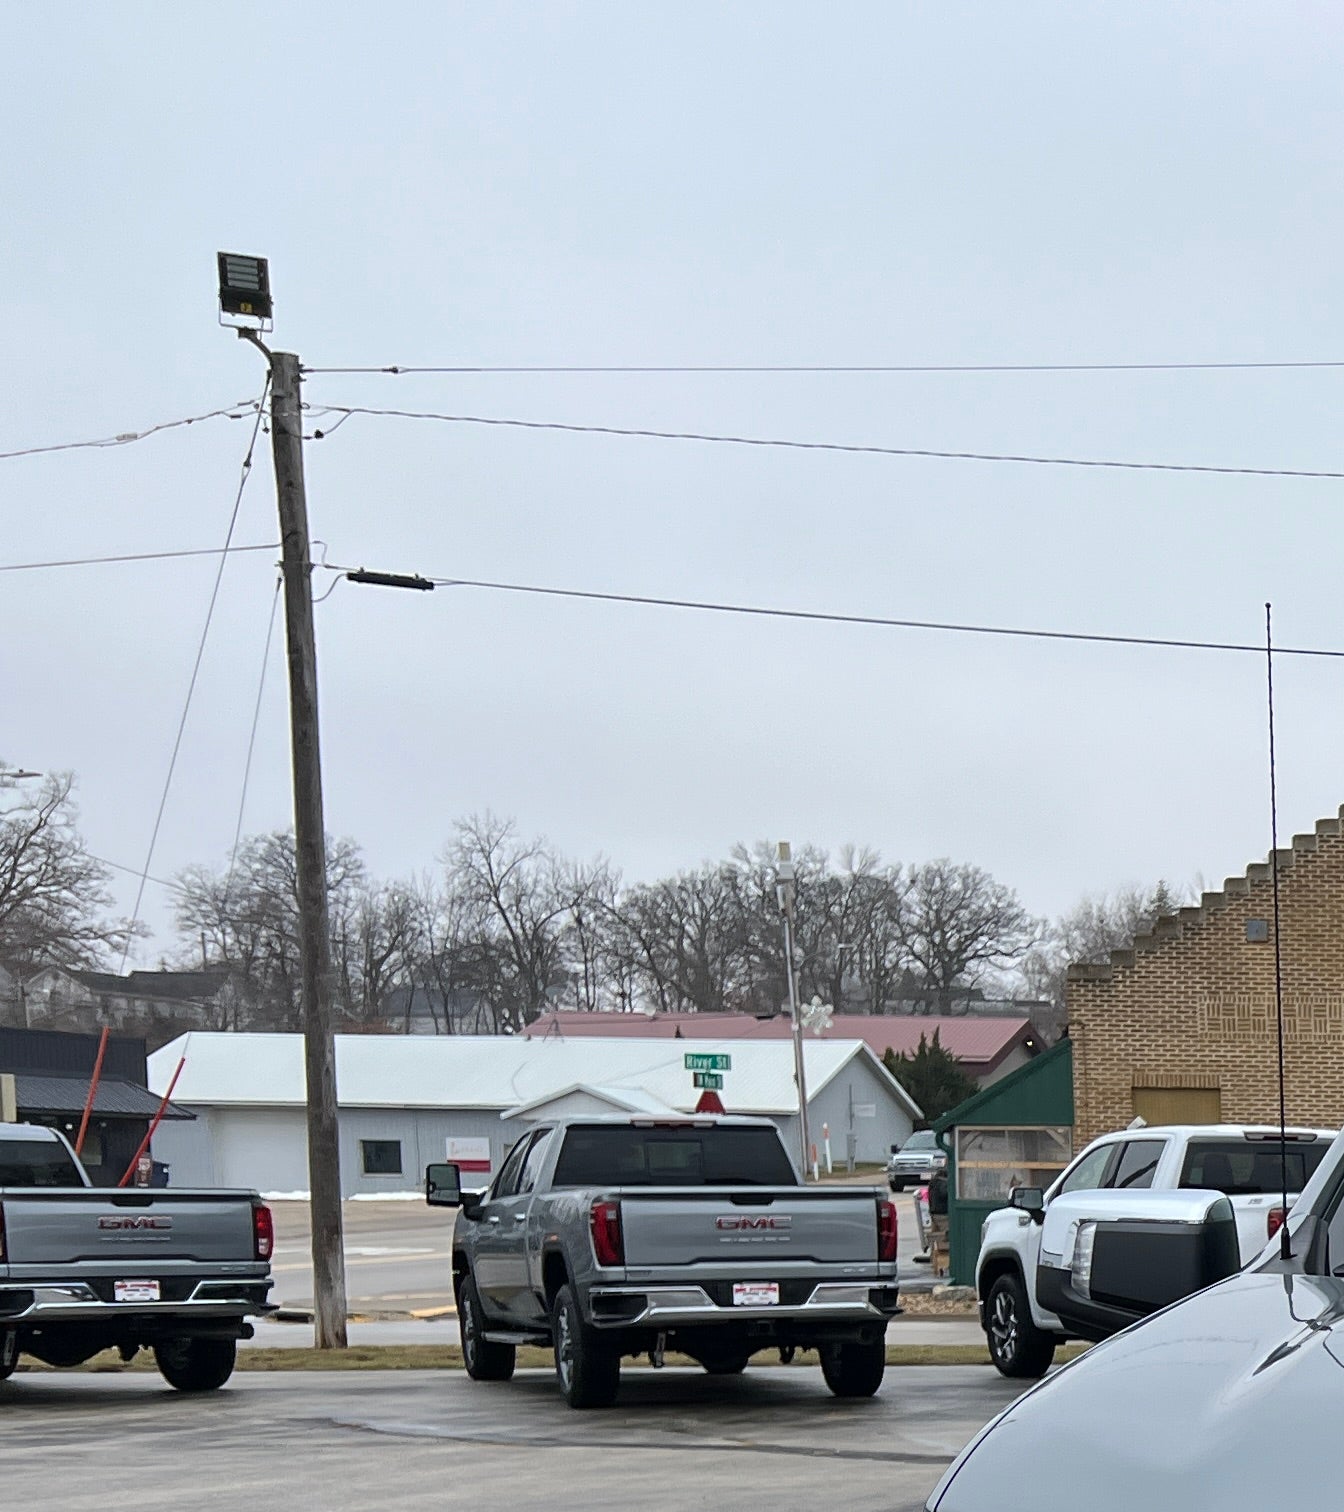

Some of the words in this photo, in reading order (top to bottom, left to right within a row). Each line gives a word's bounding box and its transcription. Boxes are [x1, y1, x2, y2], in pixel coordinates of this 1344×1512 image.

[686, 1055, 713, 1069] River
[716, 1055, 727, 1069] St
[97, 1216, 173, 1231] GMC
[716, 1215, 792, 1231] GMC
